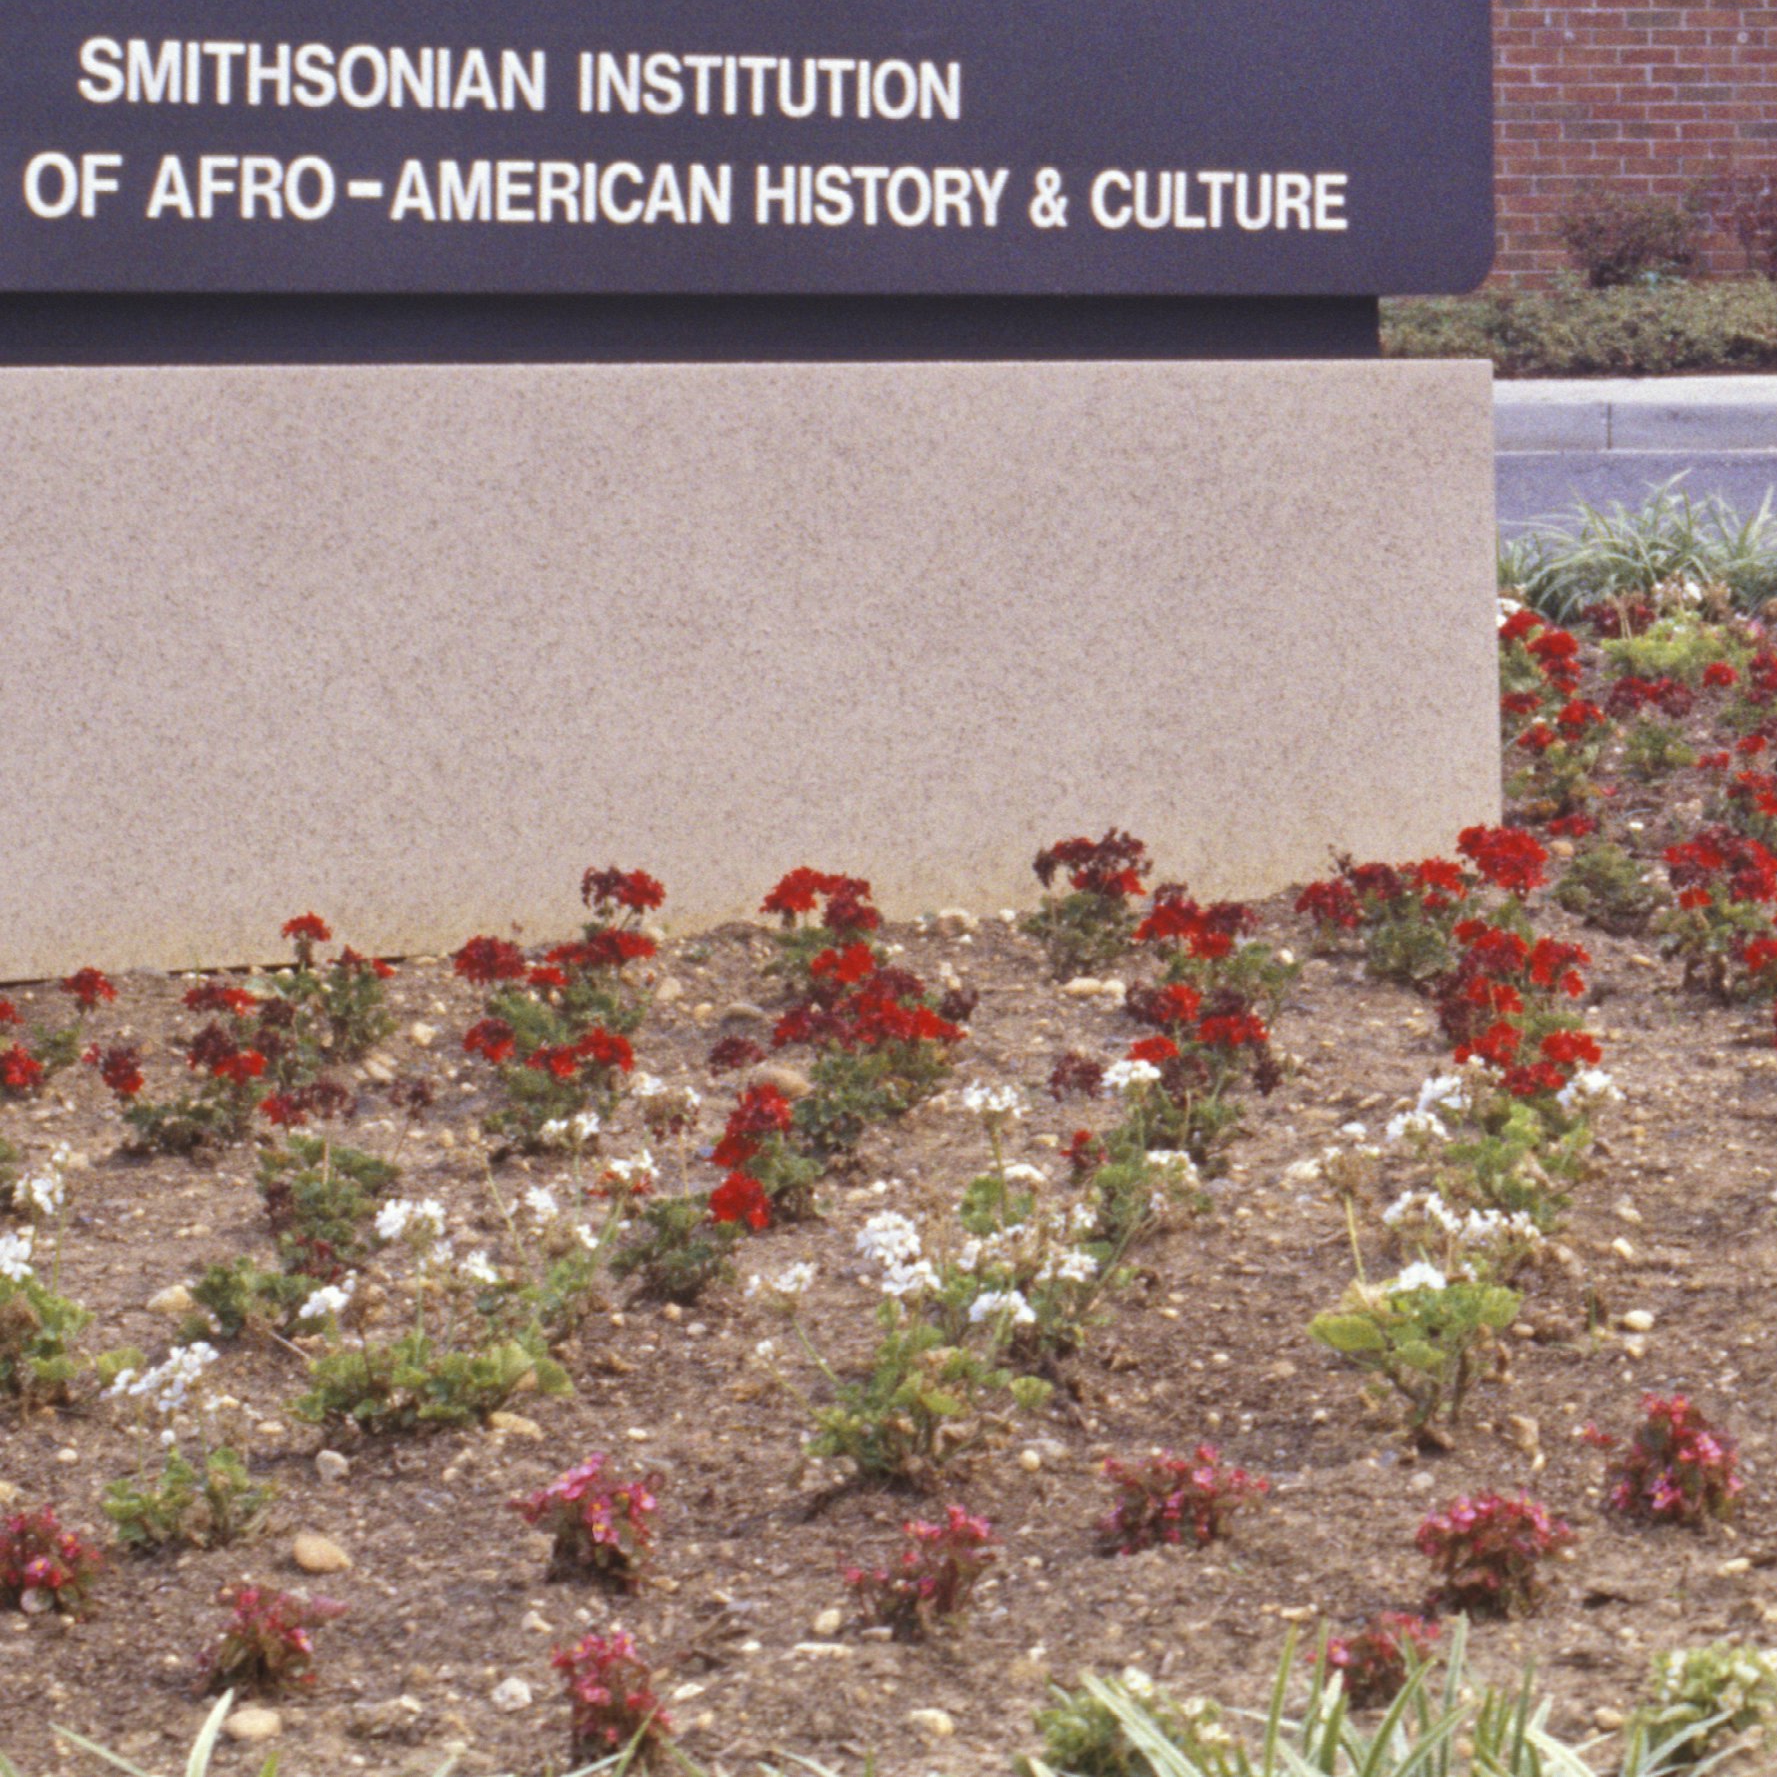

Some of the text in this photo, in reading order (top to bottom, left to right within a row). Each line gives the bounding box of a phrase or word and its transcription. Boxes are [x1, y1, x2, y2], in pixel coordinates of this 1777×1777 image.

[78, 37, 961, 120] SMITHSONIAN INSTITUTION
[24, 152, 123, 218] OF
[756, 164, 1010, 227] HISTORY
[1029, 167, 1068, 228] &
[1091, 169, 1348, 230] CULTURE
